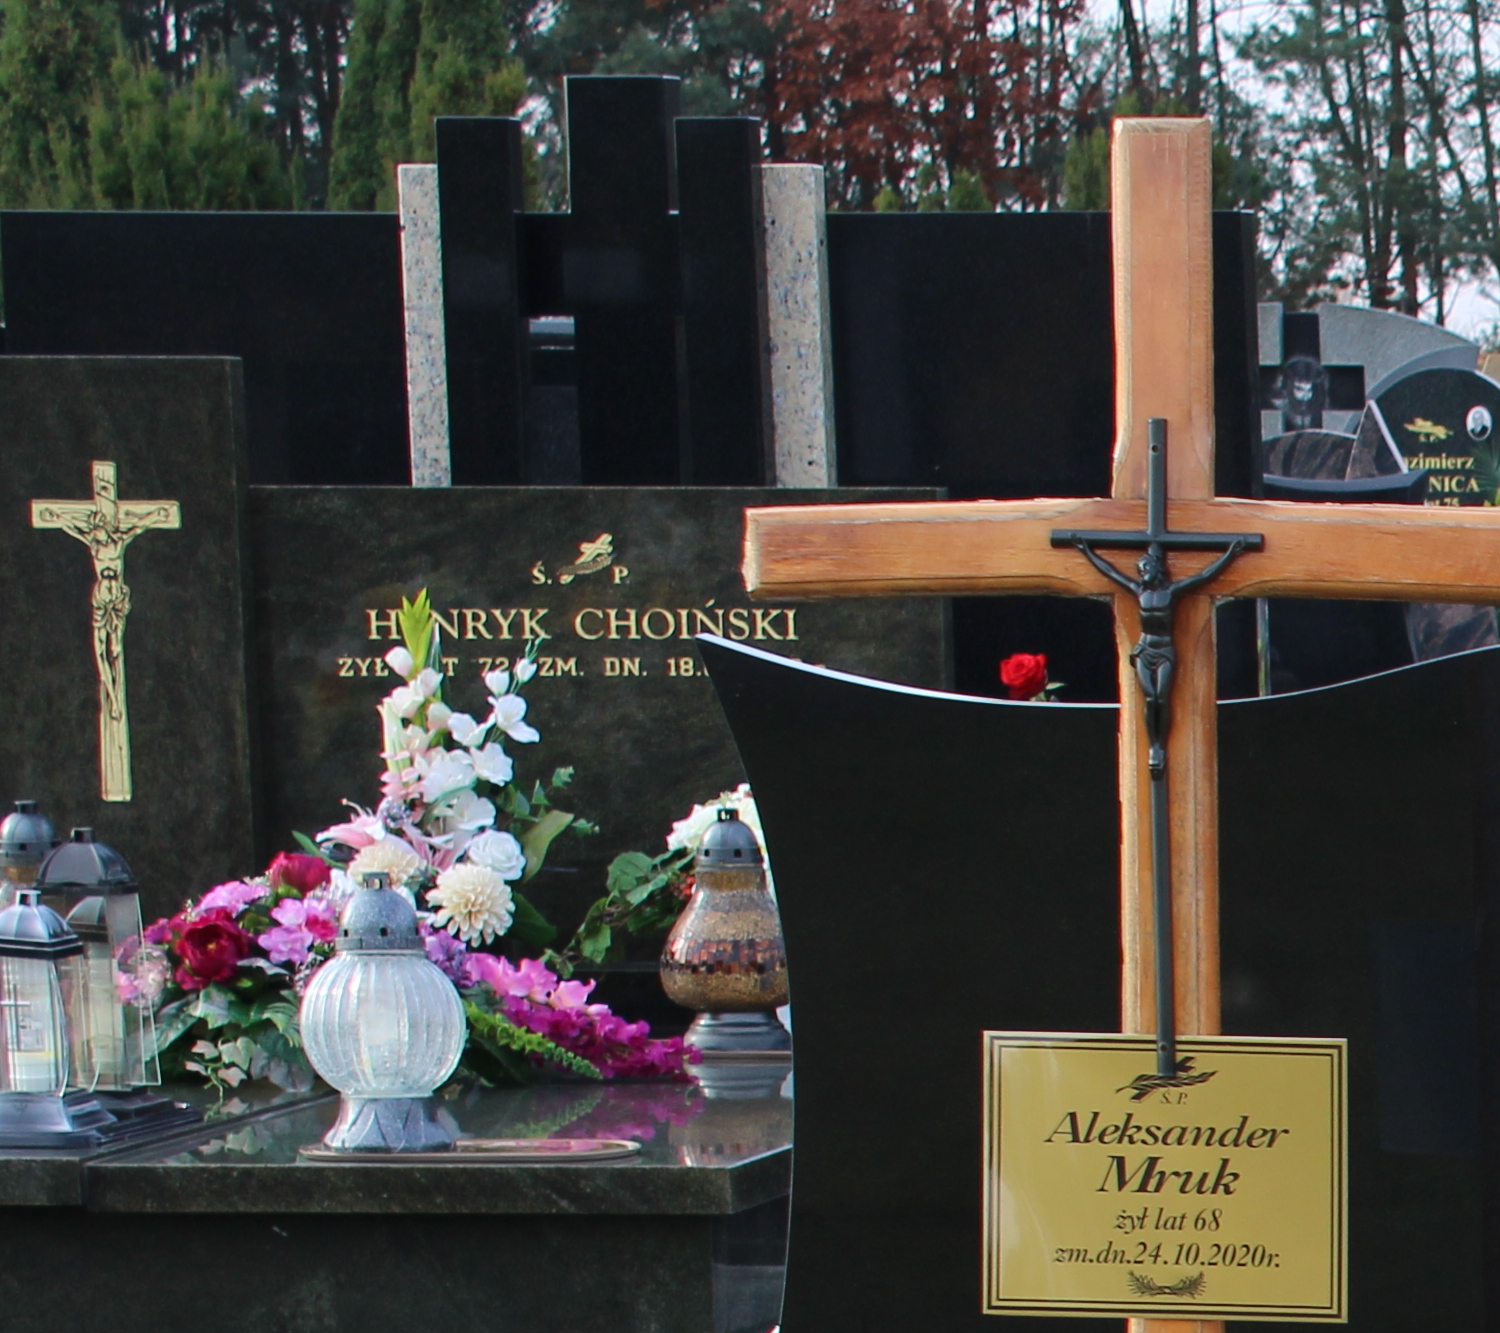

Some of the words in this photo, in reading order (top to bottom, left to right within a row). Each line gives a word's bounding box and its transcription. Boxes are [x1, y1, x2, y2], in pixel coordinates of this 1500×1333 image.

[366, 608, 552, 641] HNRYK
[574, 599, 799, 640] CHOIŃSKI
[604, 656, 648, 677] DN.
[1044, 1110, 1290, 1149] Aleksander
[1095, 1155, 1241, 1196] Mruk
[1114, 1206, 1149, 1235] żył
[1155, 1208, 1188, 1231] lat
[1194, 1208, 1223, 1232] 68
